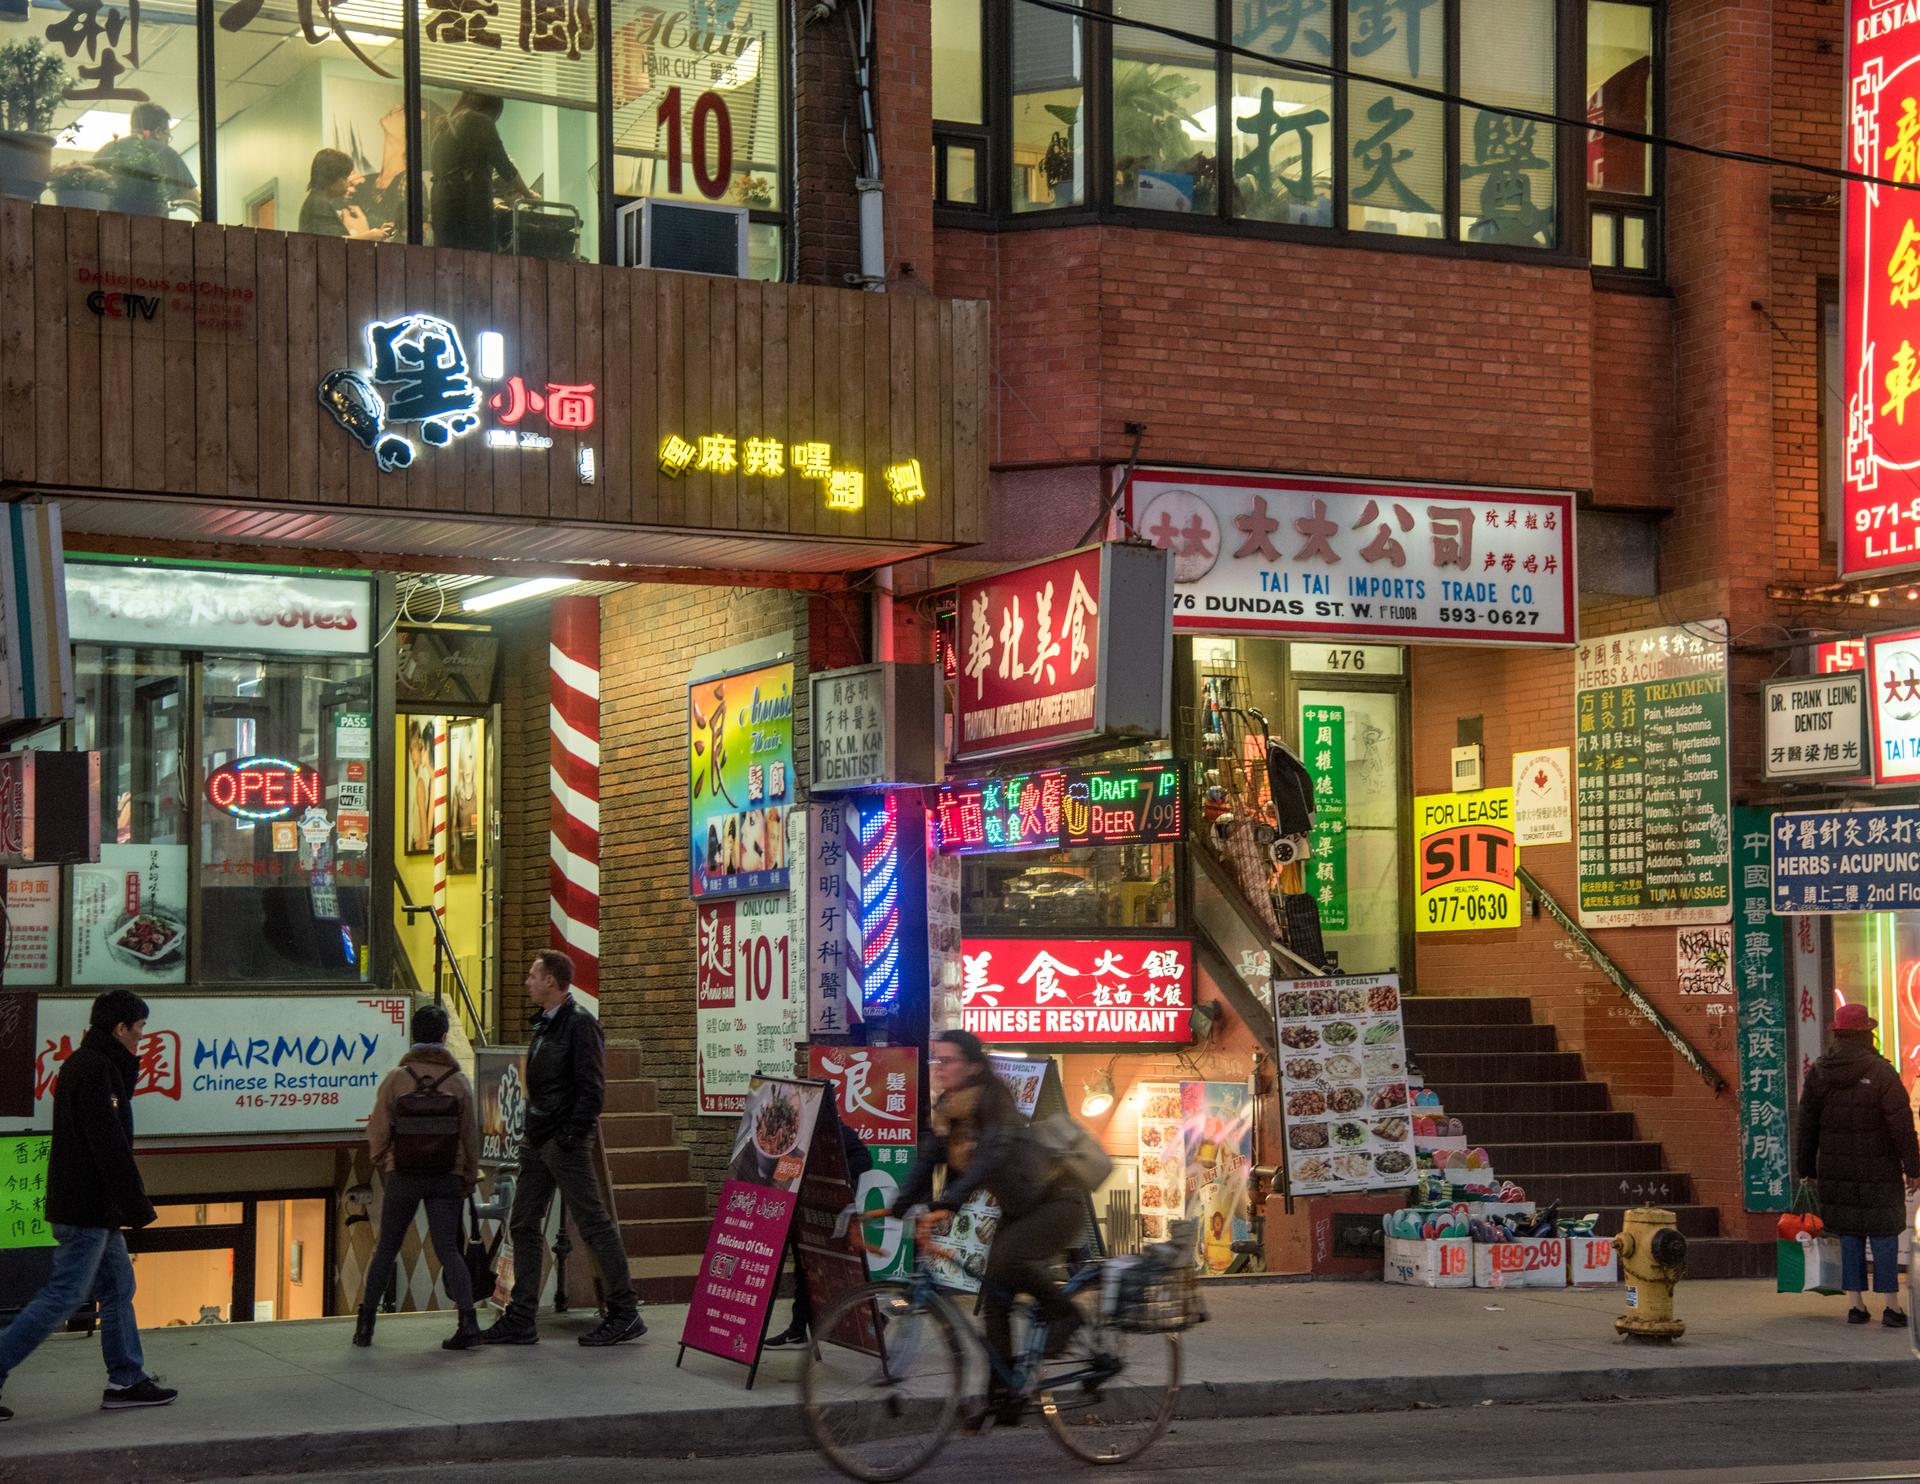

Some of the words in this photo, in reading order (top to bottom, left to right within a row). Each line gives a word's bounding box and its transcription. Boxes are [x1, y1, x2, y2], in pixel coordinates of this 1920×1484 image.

[641, 54, 672, 76] HAIR
[674, 59, 698, 79] CUT
[657, 85, 733, 200] 10
[86, 290, 160, 320] CCTV
[489, 375, 596, 429] 小面
[1260, 571, 1289, 593] TAI
[1303, 574, 1330, 595] TAI
[1349, 576, 1426, 600] IMPORTS
[1442, 581, 1498, 605] TRADE
[1206, 596, 1304, 616] DUNDAS
[1316, 601, 1345, 618] ST.
[1351, 602, 1373, 619] W.
[1390, 605, 1417, 621] FLOOR
[1439, 607, 1540, 626] 593-0627
[1327, 650, 1366, 671] 476
[1578, 666, 1617, 690] HERBS
[1620, 666, 1629, 683] &
[1644, 676, 1724, 703] TREATMENT
[1771, 693, 1787, 712] DR.
[1791, 688, 1822, 710] FRANK
[1827, 685, 1857, 706] LEUNG
[341, 716, 367, 727] PASS
[1644, 707, 1664, 721] Pain,
[1664, 702, 1703, 719] Headache
[1794, 711, 1834, 733] DENTIST
[1676, 717, 1711, 734] Insomnia
[836, 735, 858, 755] K.M.
[1672, 735, 1721, 752] Hypertension
[1885, 738, 1905, 760] TAI
[826, 754, 877, 780] DENTIST
[1682, 753, 1712, 767] Asthma
[212, 771, 319, 806] OPEN
[340, 785, 364, 794] FREE
[1091, 776, 1139, 801] DRAFT
[1680, 786, 1702, 801] Injury
[1092, 805, 1135, 835] BEER
[1425, 804, 1454, 826] FOR
[1458, 798, 1509, 823] LEASE
[1522, 831, 1545, 841] TORONTO
[1546, 830, 1563, 839] OFFICE
[1646, 839, 1663, 852] Skin
[1664, 837, 1701, 851] disorders
[1425, 832, 1509, 880] SIT
[1686, 851, 1729, 867] Overweight
[1777, 855, 1830, 876] HERBS
[1647, 871, 1696, 885] Hemorrhoids
[1454, 885, 1480, 894] REALTOR
[1680, 885, 1727, 900] MASSAGE
[1867, 883, 1895, 902] 2nd
[743, 899, 761, 917] ONLY
[763, 898, 781, 915] CUT
[1428, 893, 1508, 925] 977-0630
[1335, 977, 1380, 988] SPECIALTY
[718, 1018, 732, 1032] Color
[1046, 1010, 1179, 1033] RESTAURANT
[193, 1032, 380, 1071] HARMONY
[718, 1045, 731, 1057] Perm
[1012, 1063, 1037, 1074] SPECIALTY
[193, 1072, 268, 1093] Chinese
[274, 1070, 379, 1091] Restaurant
[235, 1092, 340, 1109] 416-729-9788
[877, 1127, 912, 1141] HAIR
[482, 1135, 501, 1158] BBQ
[716, 1232, 746, 1251] Delicious
[746, 1239, 754, 1252] Of
[754, 1241, 774, 1257] China
